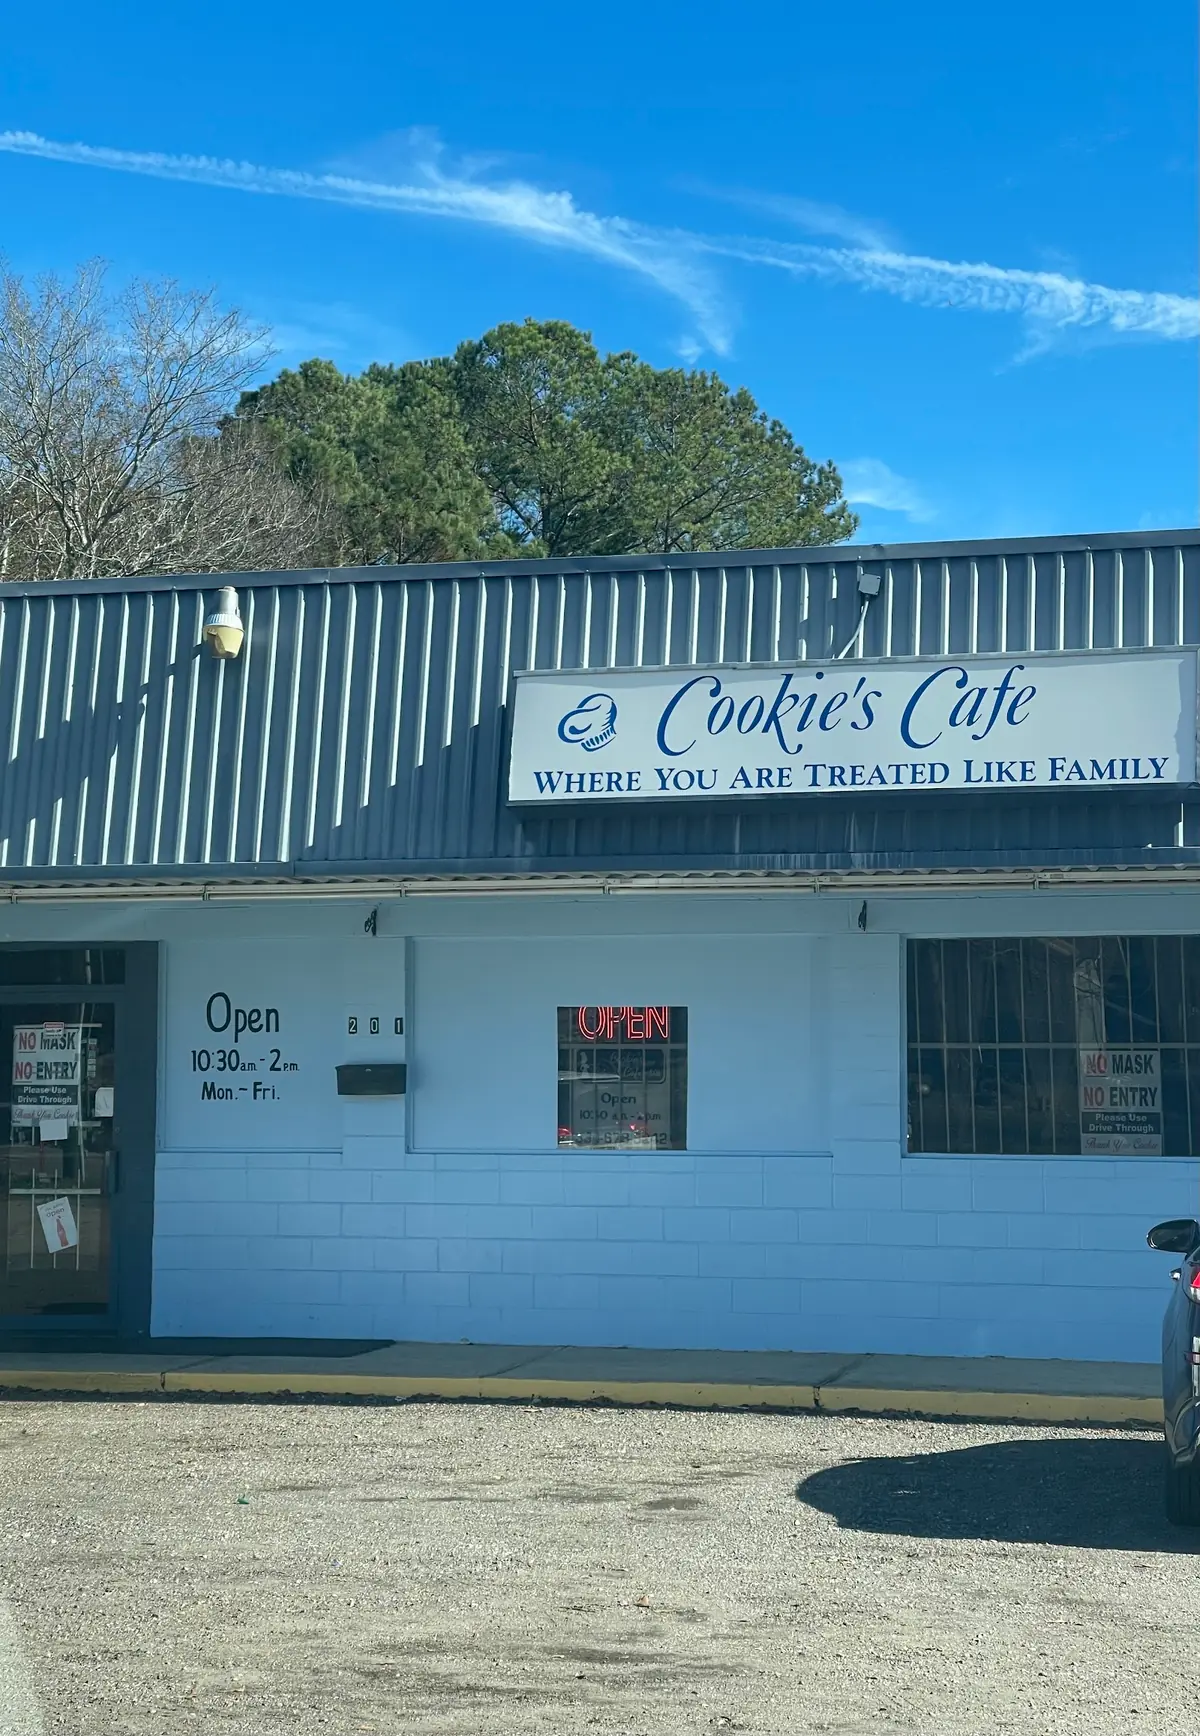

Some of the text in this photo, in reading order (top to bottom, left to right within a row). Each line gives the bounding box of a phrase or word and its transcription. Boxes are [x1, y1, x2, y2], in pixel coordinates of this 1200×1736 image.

[656, 664, 1037, 757] Cookie's Cafe
[533, 756, 1169, 794] WHERE YOU ARE TREATED LIKE FAMILY
[206, 991, 280, 1043] Open
[578, 1006, 669, 1040] OPEN
[18, 1031, 37, 1050] NO
[15, 1061, 78, 1080] NO ENTRY
[1086, 1053, 1154, 1075] NO MASK
[18, 1095, 72, 1104] Drive Through
[23, 1086, 67, 1094] Please Use
[600, 1092, 637, 1107] Open
[1083, 1086, 1158, 1107] NO ENTRY
[1095, 1113, 1147, 1122] Please Use
[1088, 1123, 1154, 1134] Drive Through
